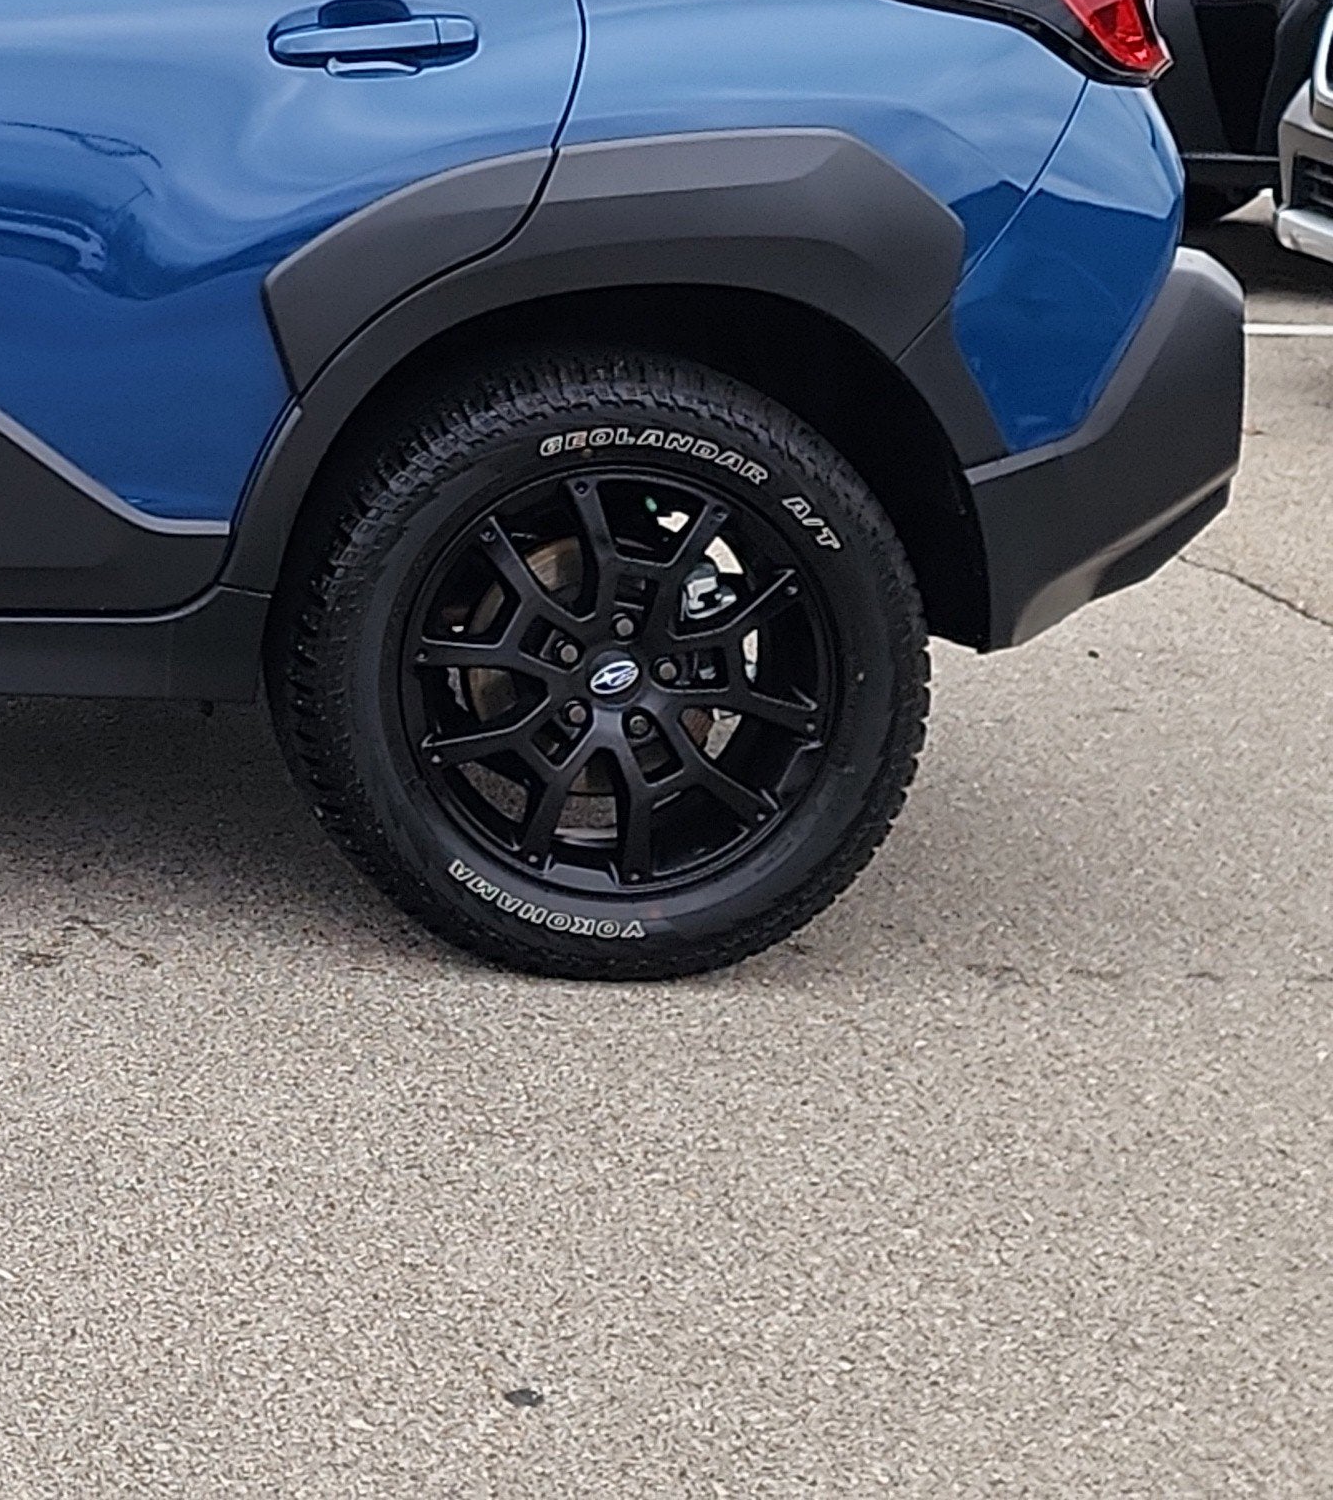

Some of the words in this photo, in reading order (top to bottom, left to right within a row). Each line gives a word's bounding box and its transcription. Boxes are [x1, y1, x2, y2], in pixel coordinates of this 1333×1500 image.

[539, 426, 769, 487] GEOLANDAR
[781, 495, 842, 551] A/T
[447, 858, 647, 939] YOKOHAMA
